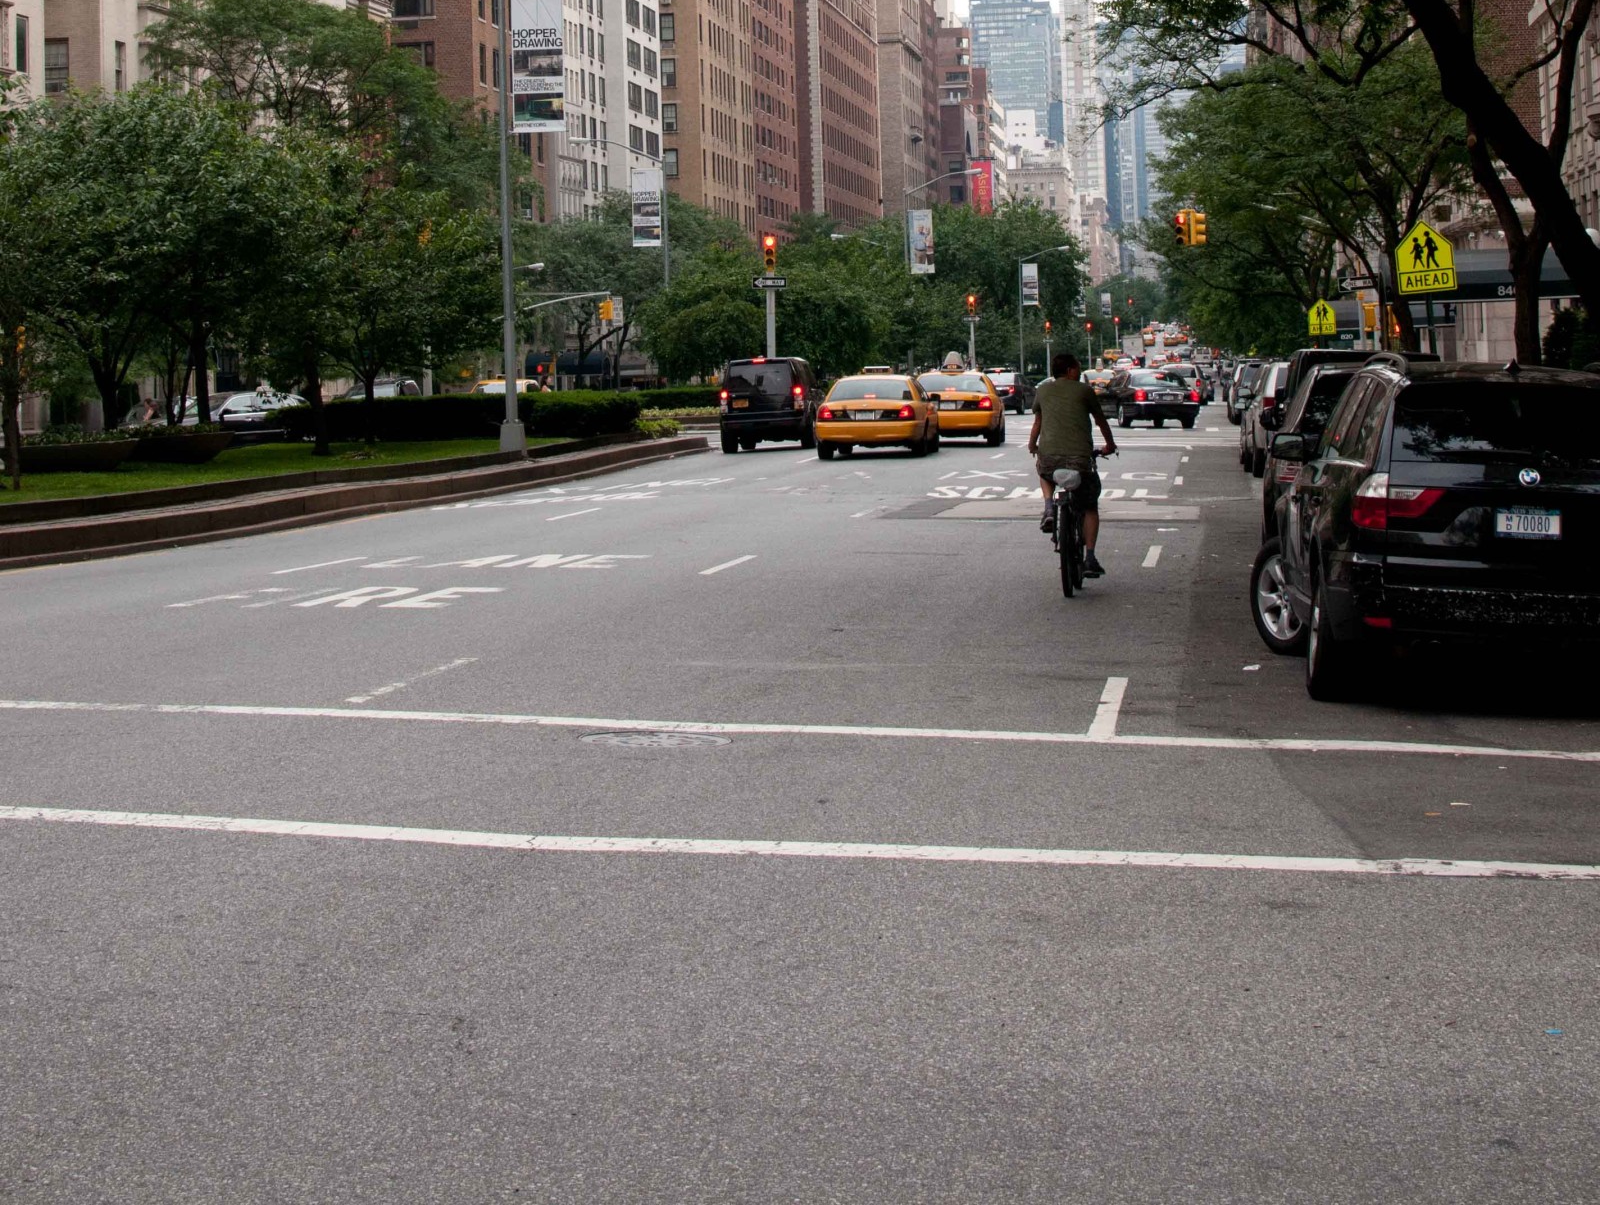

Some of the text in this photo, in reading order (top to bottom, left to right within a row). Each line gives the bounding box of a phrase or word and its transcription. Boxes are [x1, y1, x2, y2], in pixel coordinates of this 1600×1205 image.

[512, 28, 557, 38] HOPPER
[512, 37, 563, 48] DRAWING
[978, 172, 990, 195] Asia
[1406, 272, 1449, 288] AHEAD
[1516, 515, 1550, 533] 70080
